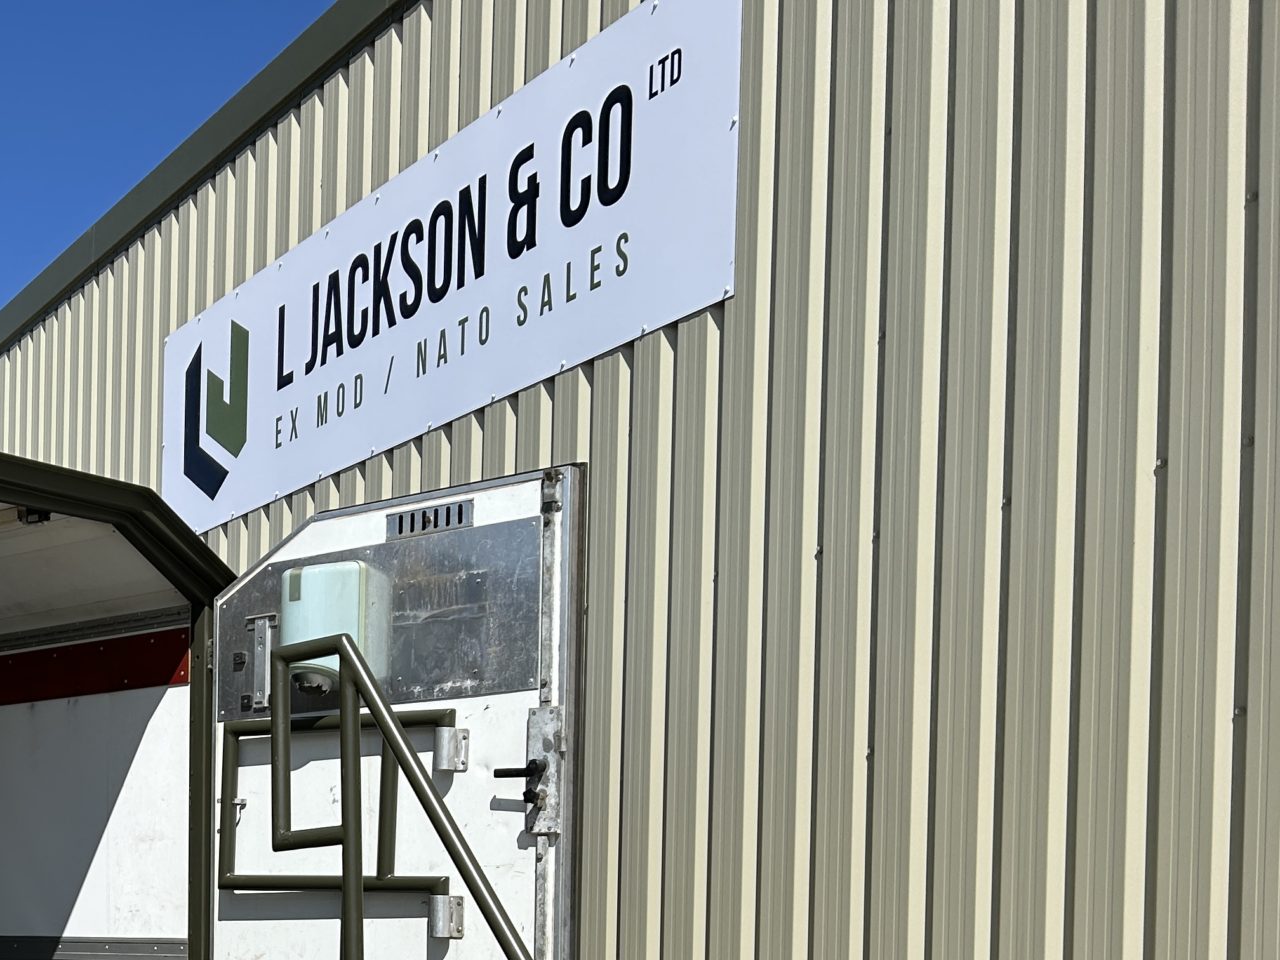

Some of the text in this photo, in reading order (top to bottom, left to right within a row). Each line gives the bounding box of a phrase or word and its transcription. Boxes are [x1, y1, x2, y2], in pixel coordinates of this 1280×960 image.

[275, 232, 629, 449] EX MOD / NATO SALES
[276, 48, 682, 391] L JACKSON & CO LTD
